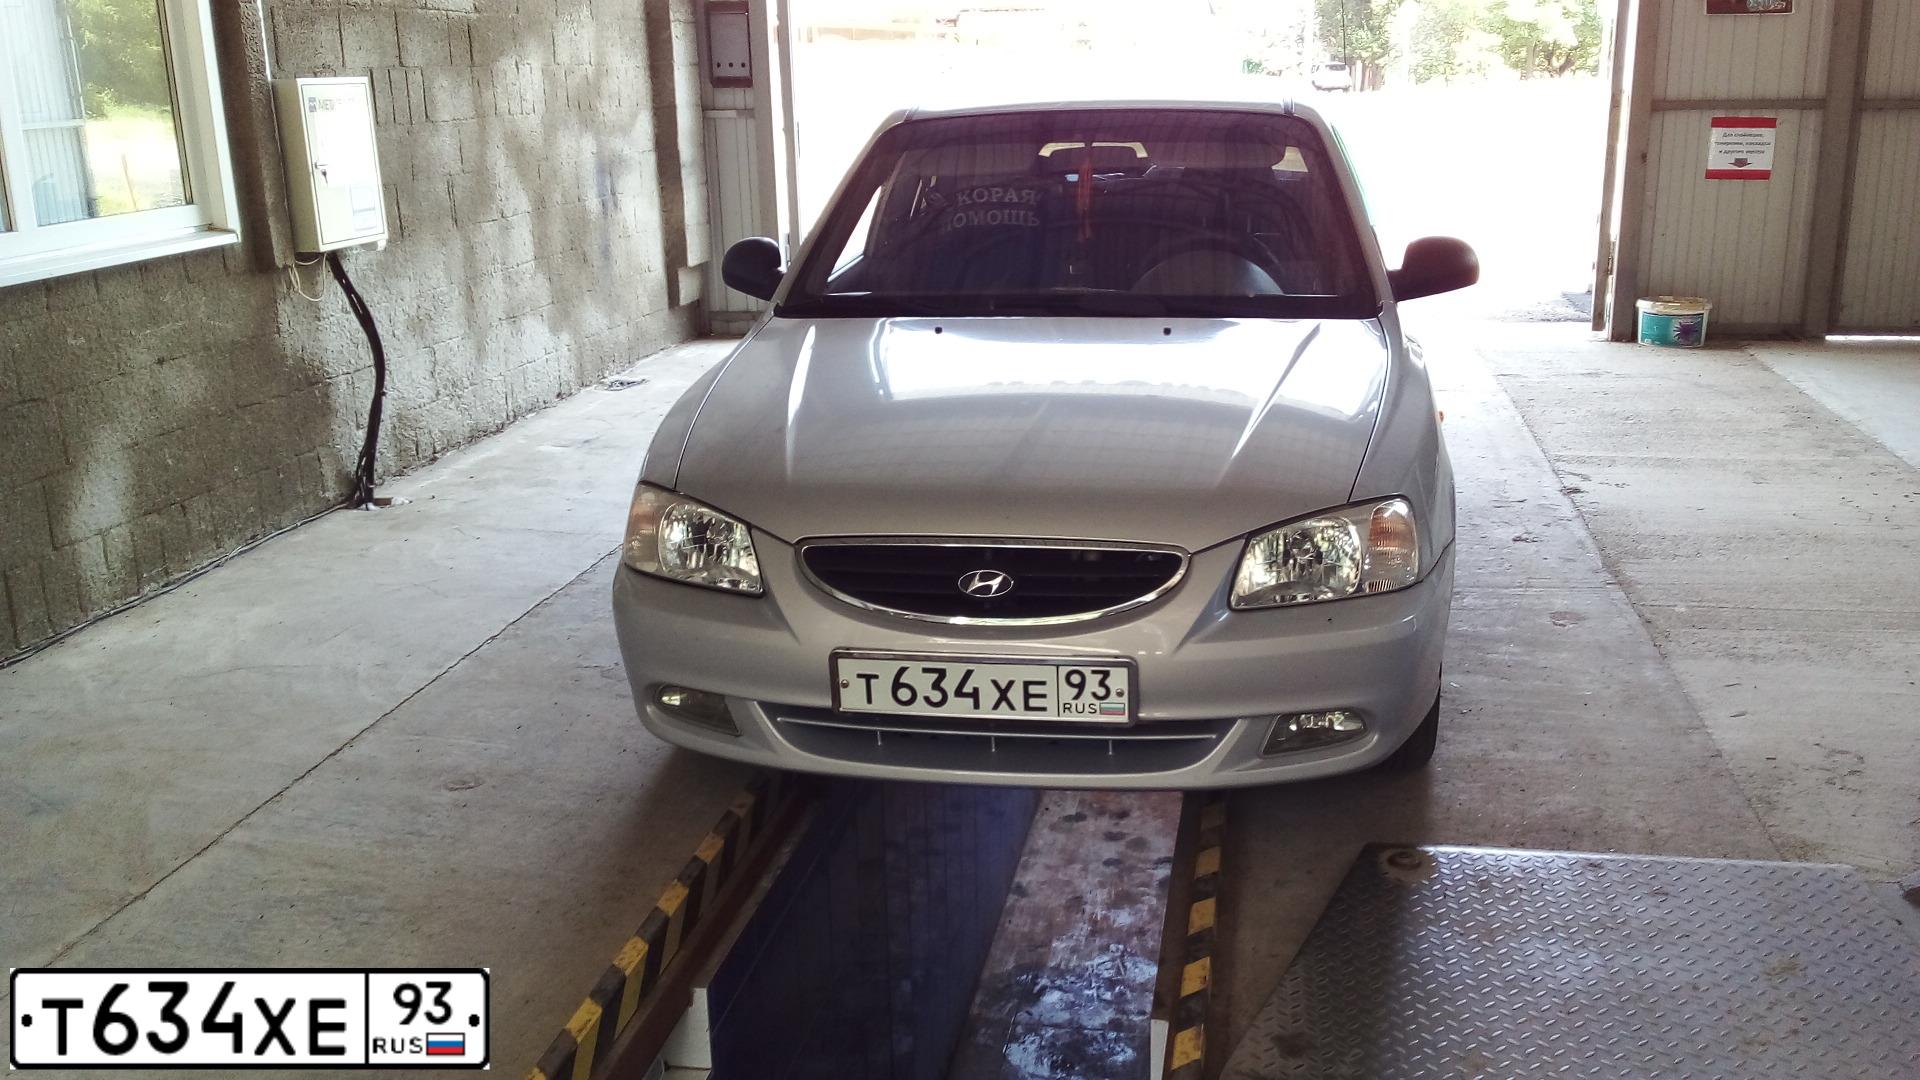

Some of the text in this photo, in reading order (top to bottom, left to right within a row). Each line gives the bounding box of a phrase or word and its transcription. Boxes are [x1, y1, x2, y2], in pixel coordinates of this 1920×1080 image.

[956, 187, 1036, 206] КОРАЯ
[1064, 669, 1112, 701] 93
[1063, 703, 1097, 714] RUS
